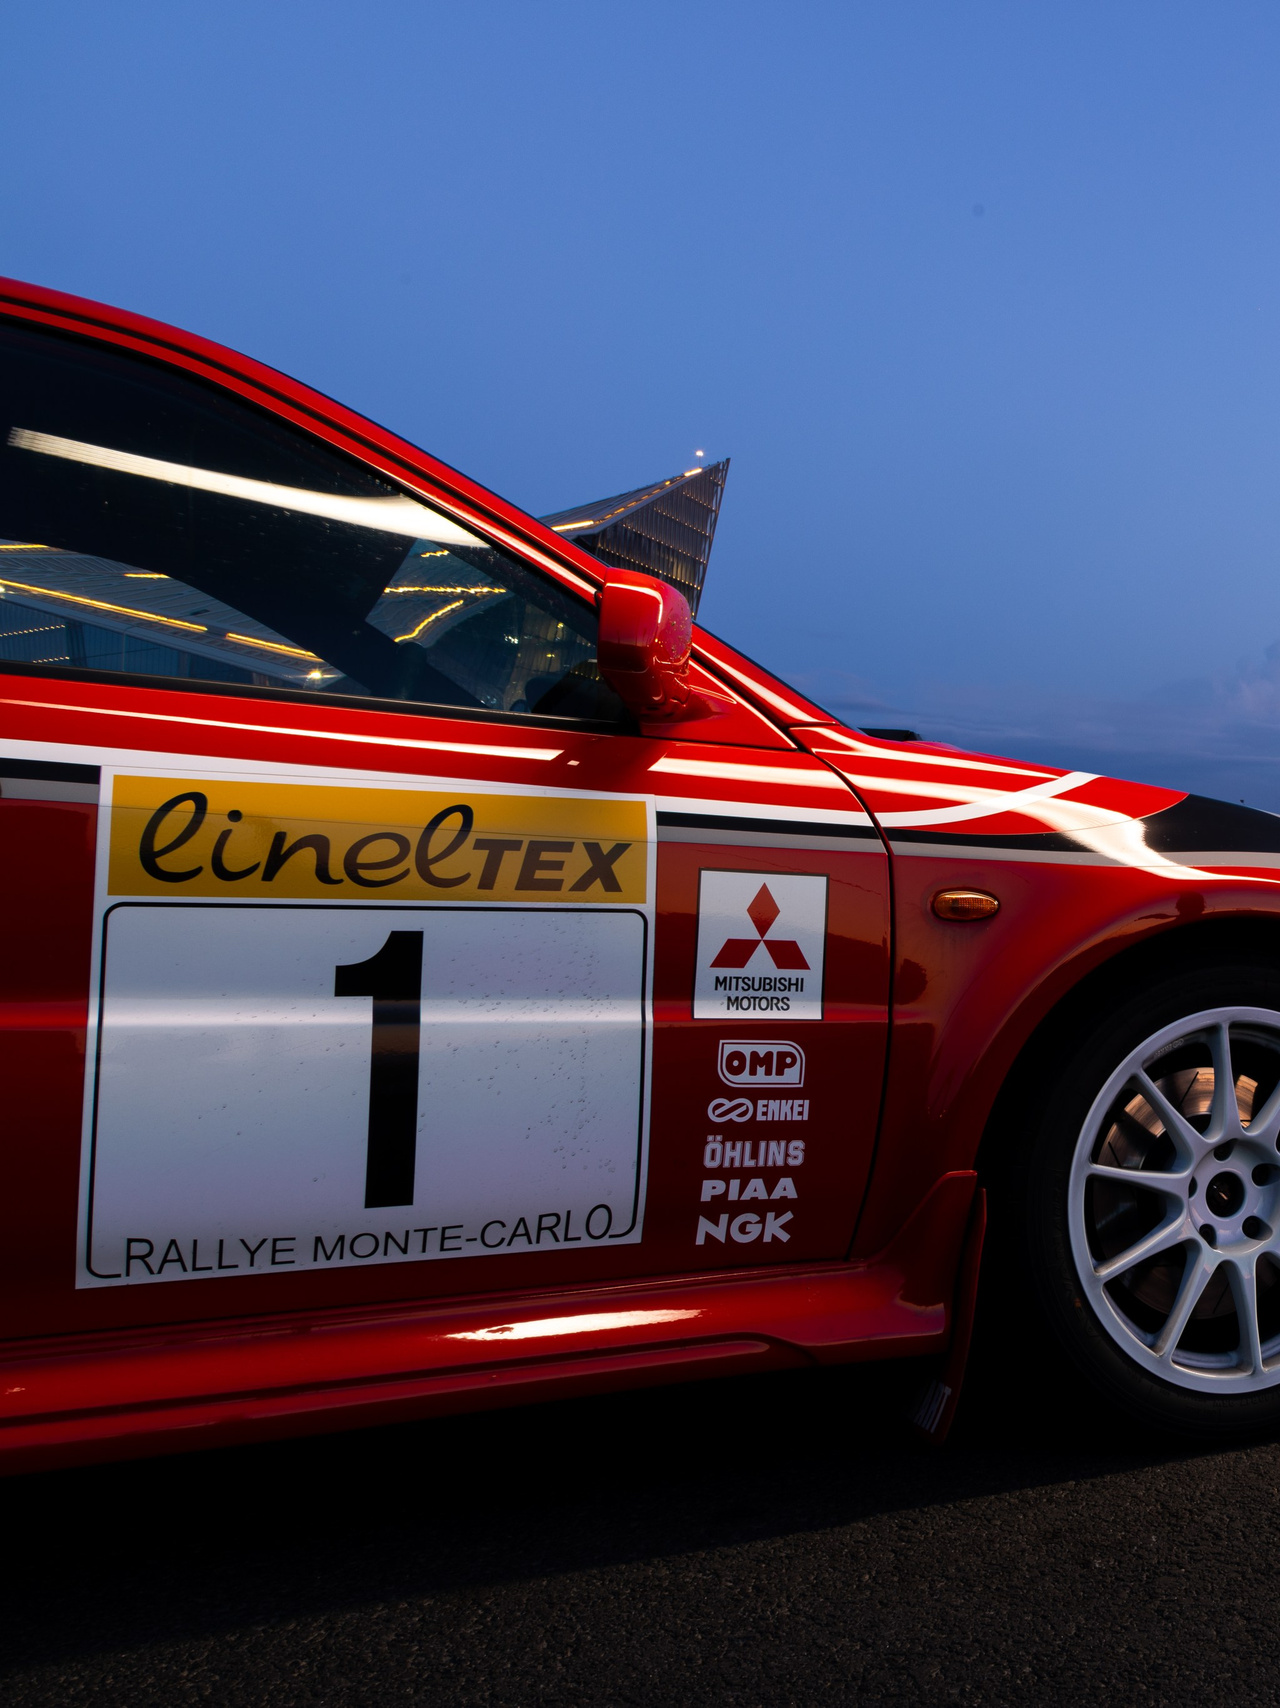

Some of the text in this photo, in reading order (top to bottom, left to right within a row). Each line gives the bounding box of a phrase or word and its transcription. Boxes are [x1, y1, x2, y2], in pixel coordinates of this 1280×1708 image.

[714, 975, 804, 993] MITSUBISHI
[726, 996, 790, 1012] MOTORS
[334, 930, 424, 1208] 1
[724, 1050, 798, 1077] OMP
[756, 1099, 809, 1121] ENKEI
[703, 1135, 805, 1169] ÖHLINS
[700, 1177, 798, 1202] PIAA
[124, 1202, 613, 1277] RALLYE MONTE-CARLO
[695, 1210, 794, 1245] NGK
